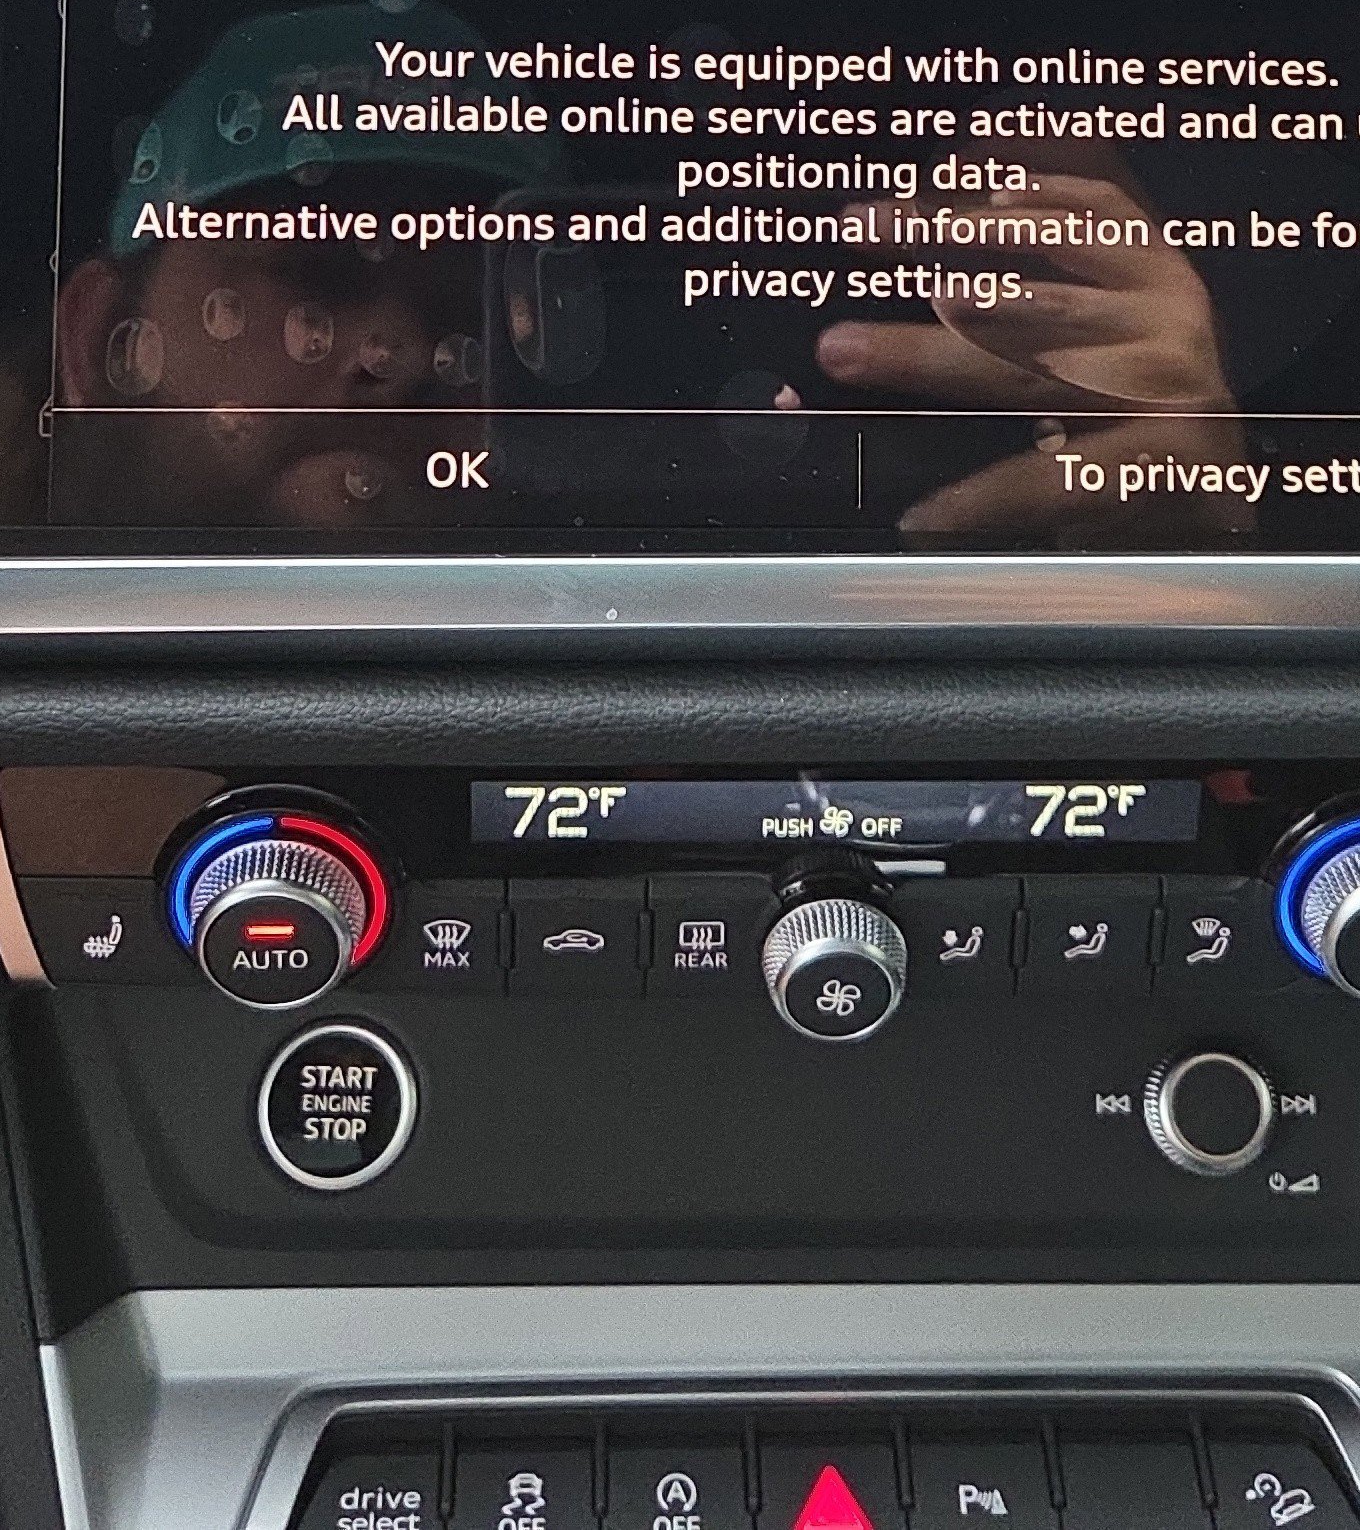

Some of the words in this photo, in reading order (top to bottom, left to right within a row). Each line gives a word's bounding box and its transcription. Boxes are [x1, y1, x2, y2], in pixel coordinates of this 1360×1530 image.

[375, 41, 474, 79] Your
[486, 42, 635, 80] vehicle
[648, 44, 681, 80] is
[694, 45, 891, 91] equipped
[904, 46, 999, 83] with
[1012, 47, 1145, 85] online
[1158, 50, 1340, 87] services.
[282, 93, 343, 133] All
[355, 95, 548, 133] available
[561, 96, 694, 134] online
[707, 99, 877, 135] services
[890, 109, 956, 136] are
[969, 102, 1165, 139] activated
[1179, 103, 1257, 139] and
[1271, 113, 1343, 141] can
[678, 152, 917, 199] positioning
[932, 153, 1041, 191] data.
[131, 201, 378, 240] Alternative
[391, 204, 555, 251] options
[568, 204, 646, 242] and
[661, 205, 881, 243] additional
[894, 207, 1149, 246] information
[1162, 218, 1236, 247] can
[1250, 210, 1301, 247] be
[684, 260, 835, 307] privacy
[847, 262, 1033, 309] settings.
[426, 451, 490, 489] OK
[1055, 454, 1105, 492] To
[1119, 455, 1271, 504] privacy
[762, 817, 814, 838] PUSH
[861, 817, 903, 838] OFF
[232, 949, 309, 971] AUTO
[423, 951, 470, 968] MAX
[674, 951, 729, 969] REAR
[300, 1066, 378, 1091] START
[301, 1094, 372, 1113] ENGINE
[303, 1117, 367, 1142] STOP
[339, 1486, 422, 1511] drive
[337, 1511, 421, 1530] select
[497, 1517, 547, 1530] OFF
[653, 1515, 701, 1530] OFF
